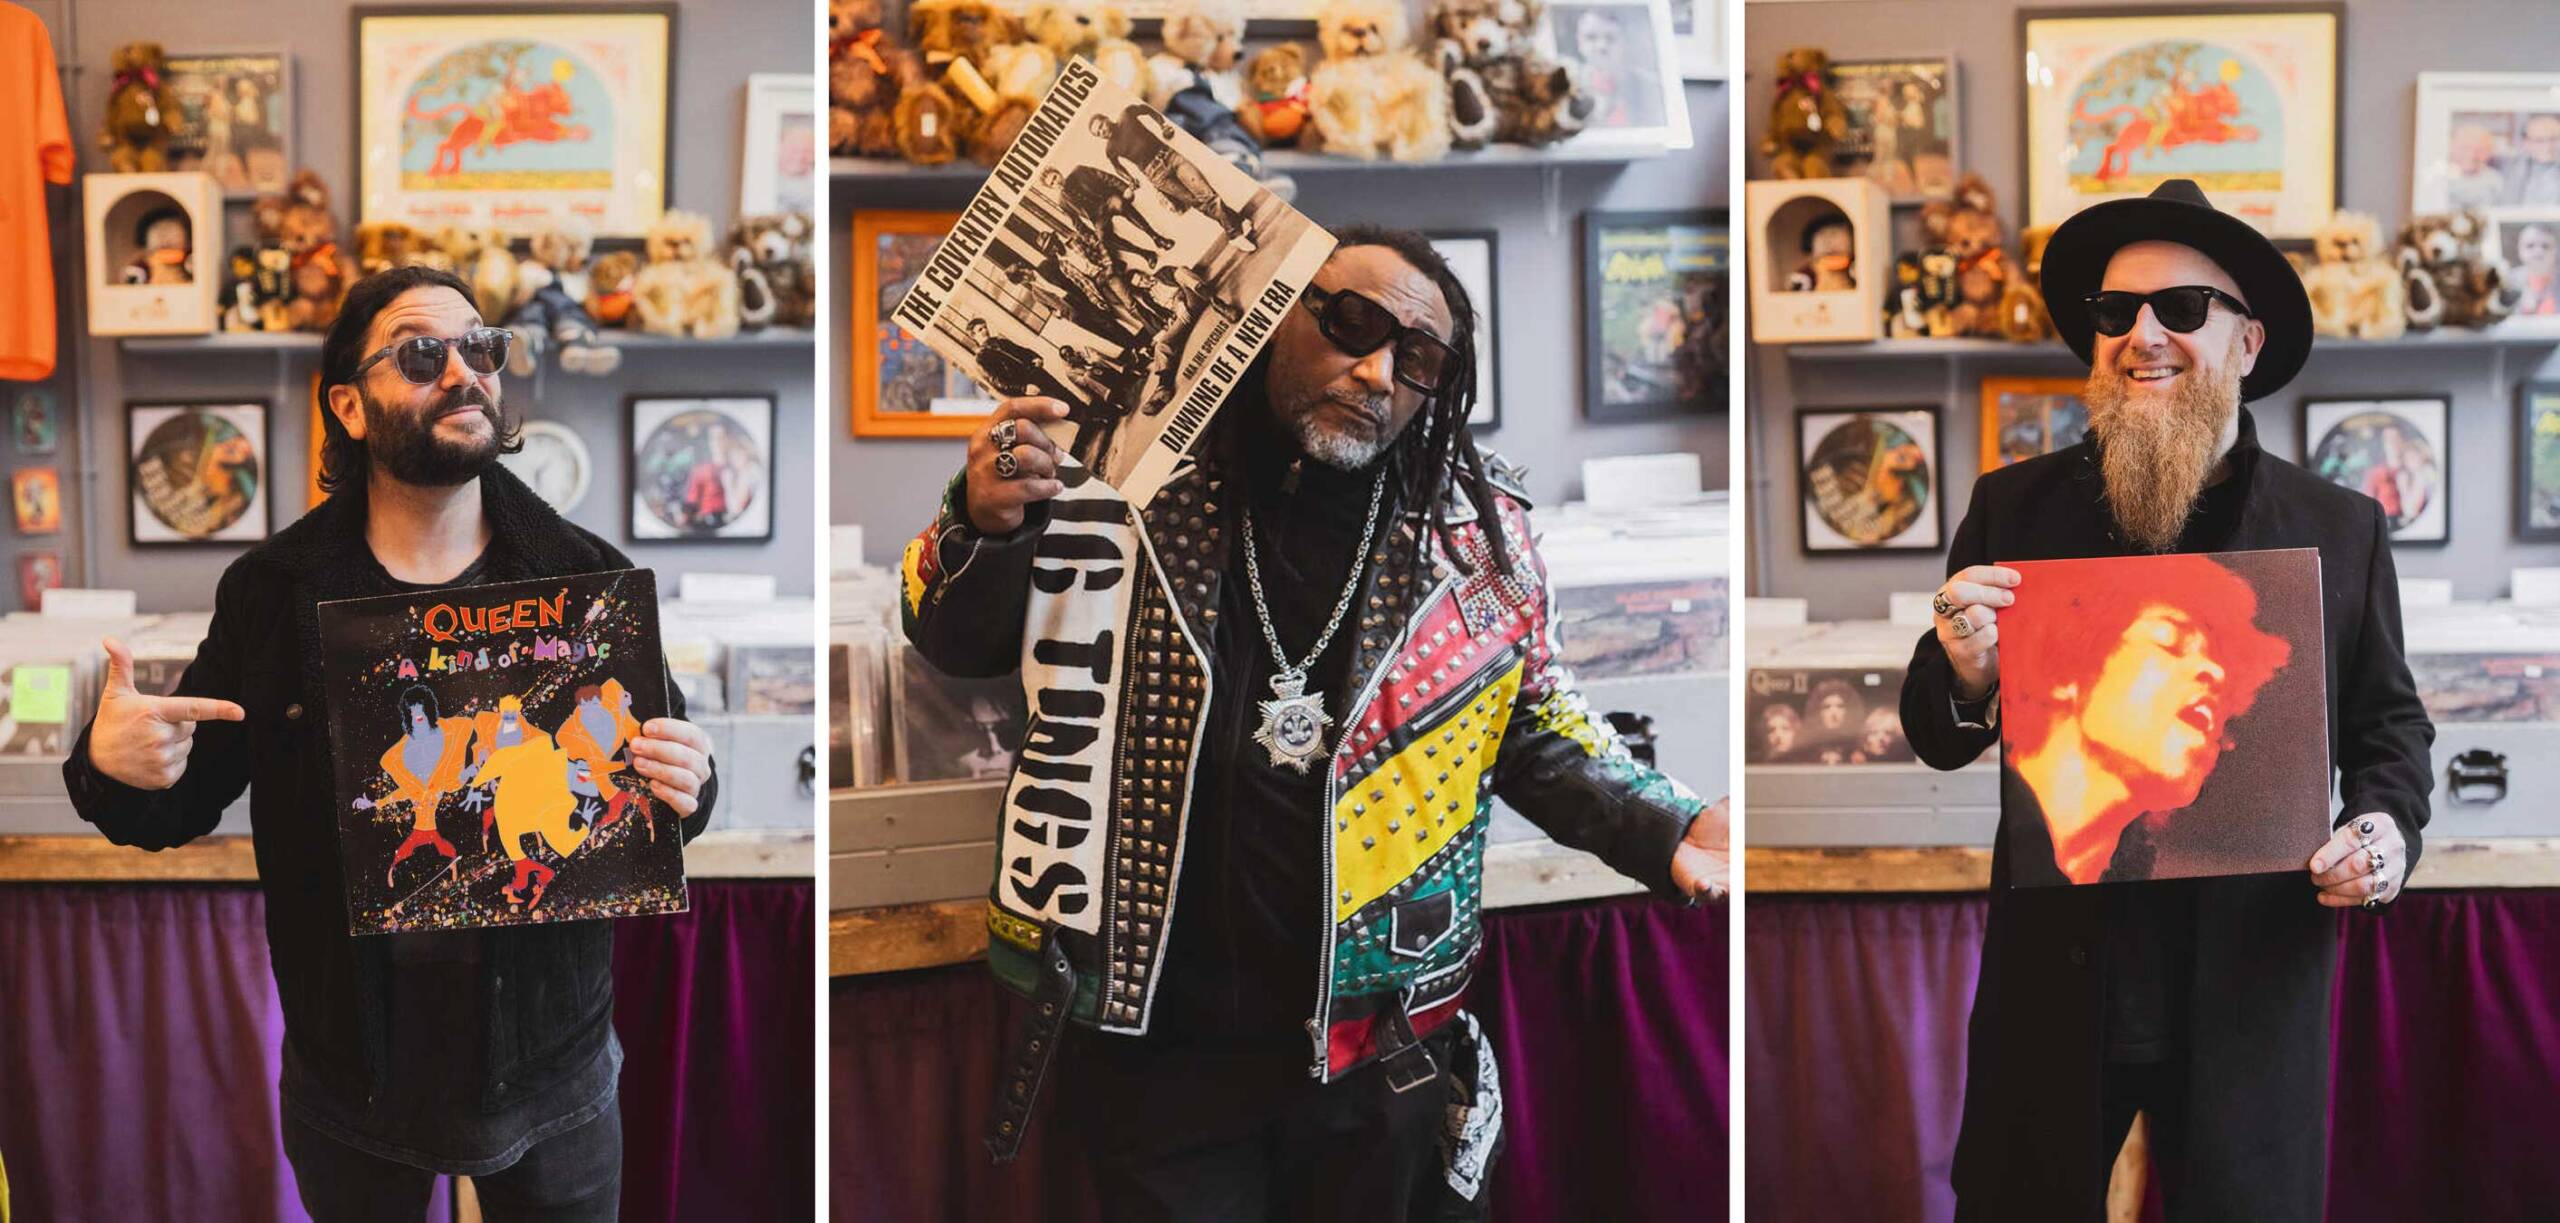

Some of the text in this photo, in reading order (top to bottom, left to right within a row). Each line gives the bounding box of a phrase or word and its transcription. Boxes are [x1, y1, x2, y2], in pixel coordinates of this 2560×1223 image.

[897, 62, 1099, 330] THE COVENTRY AUTOMATICS
[1192, 343, 1213, 367] THE
[1201, 320, 1230, 354] SPECIALS
[1159, 279, 1296, 454] DAWNING OF A NEW ERA
[423, 586, 569, 643] QUEEN
[397, 634, 613, 679] A kind of Magic
